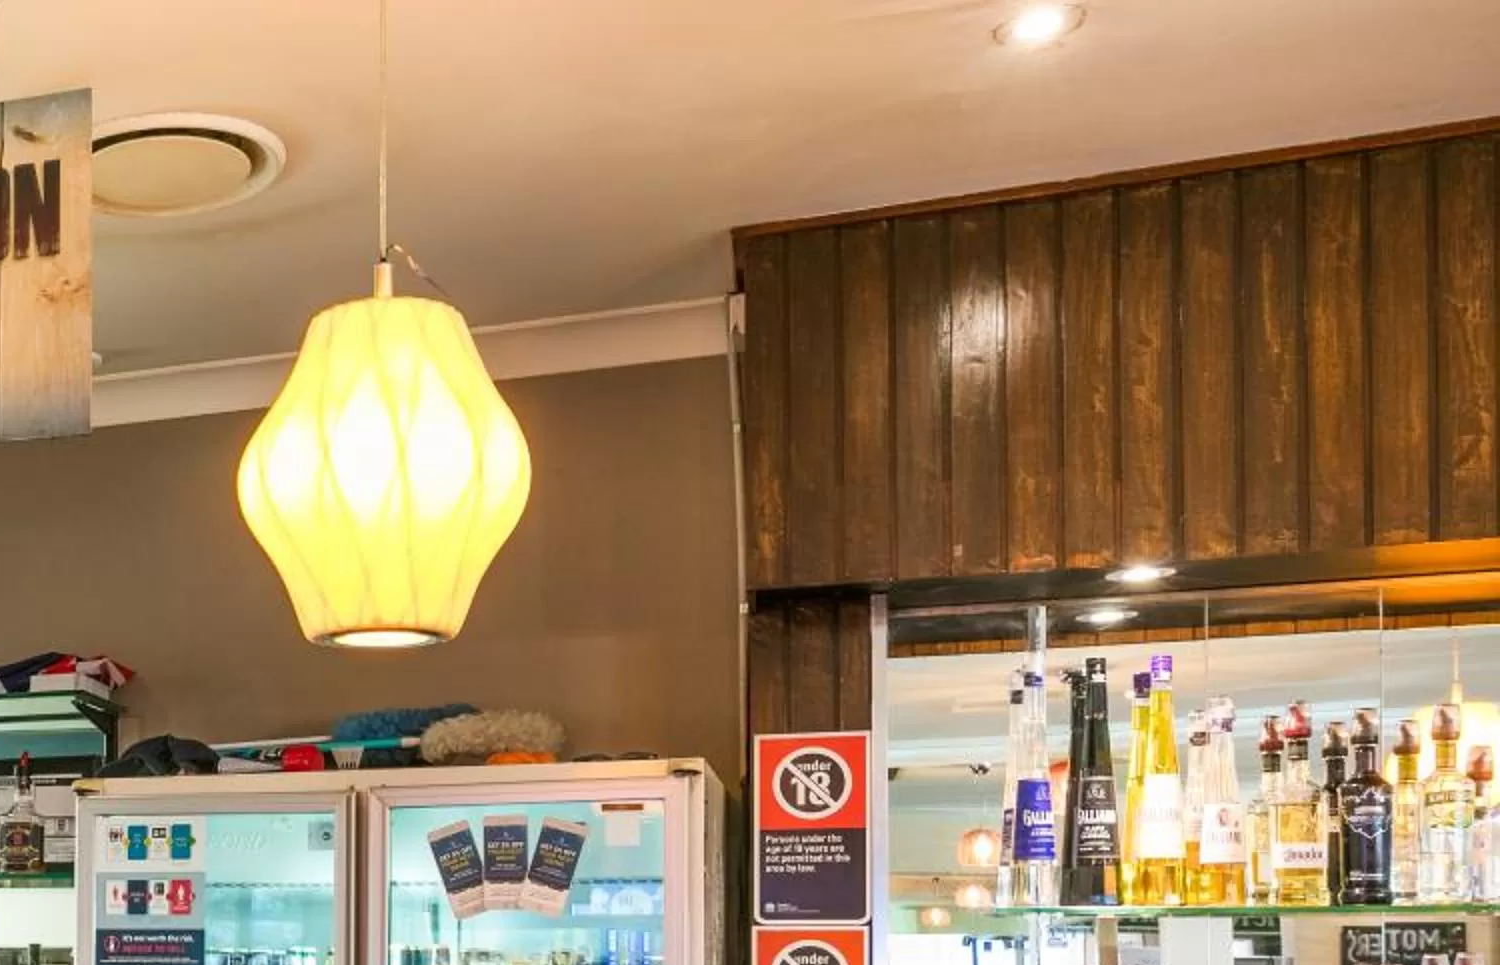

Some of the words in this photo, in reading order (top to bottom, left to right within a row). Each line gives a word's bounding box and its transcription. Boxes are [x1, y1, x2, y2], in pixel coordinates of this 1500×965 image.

[790, 772, 831, 805] 18
[802, 835, 827, 843] under
[804, 846, 828, 854] years
[781, 854, 823, 864] permitted
